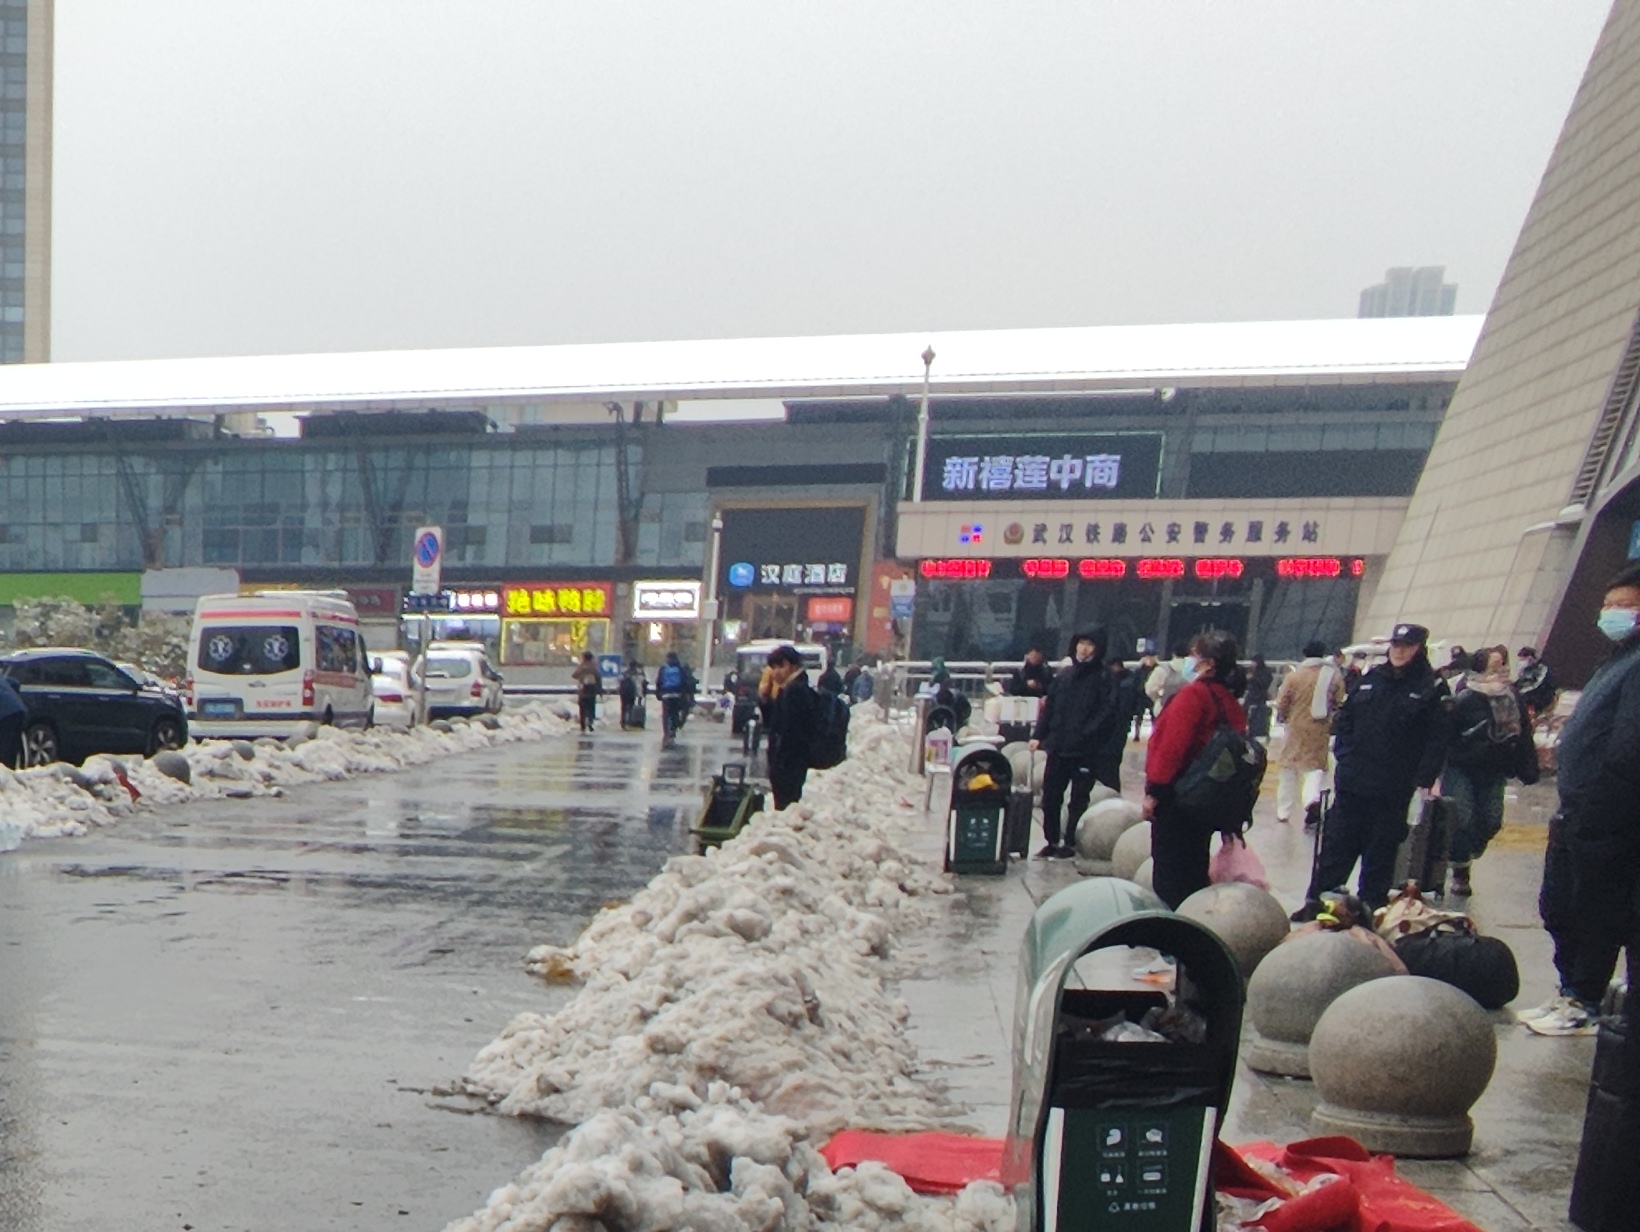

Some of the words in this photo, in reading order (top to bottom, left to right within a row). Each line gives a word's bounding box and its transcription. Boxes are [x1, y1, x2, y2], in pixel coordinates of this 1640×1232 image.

[1031, 520, 1321, 545] 武汉铁路公安警务服务站
[760, 563, 847, 585] 汉庭酒店
